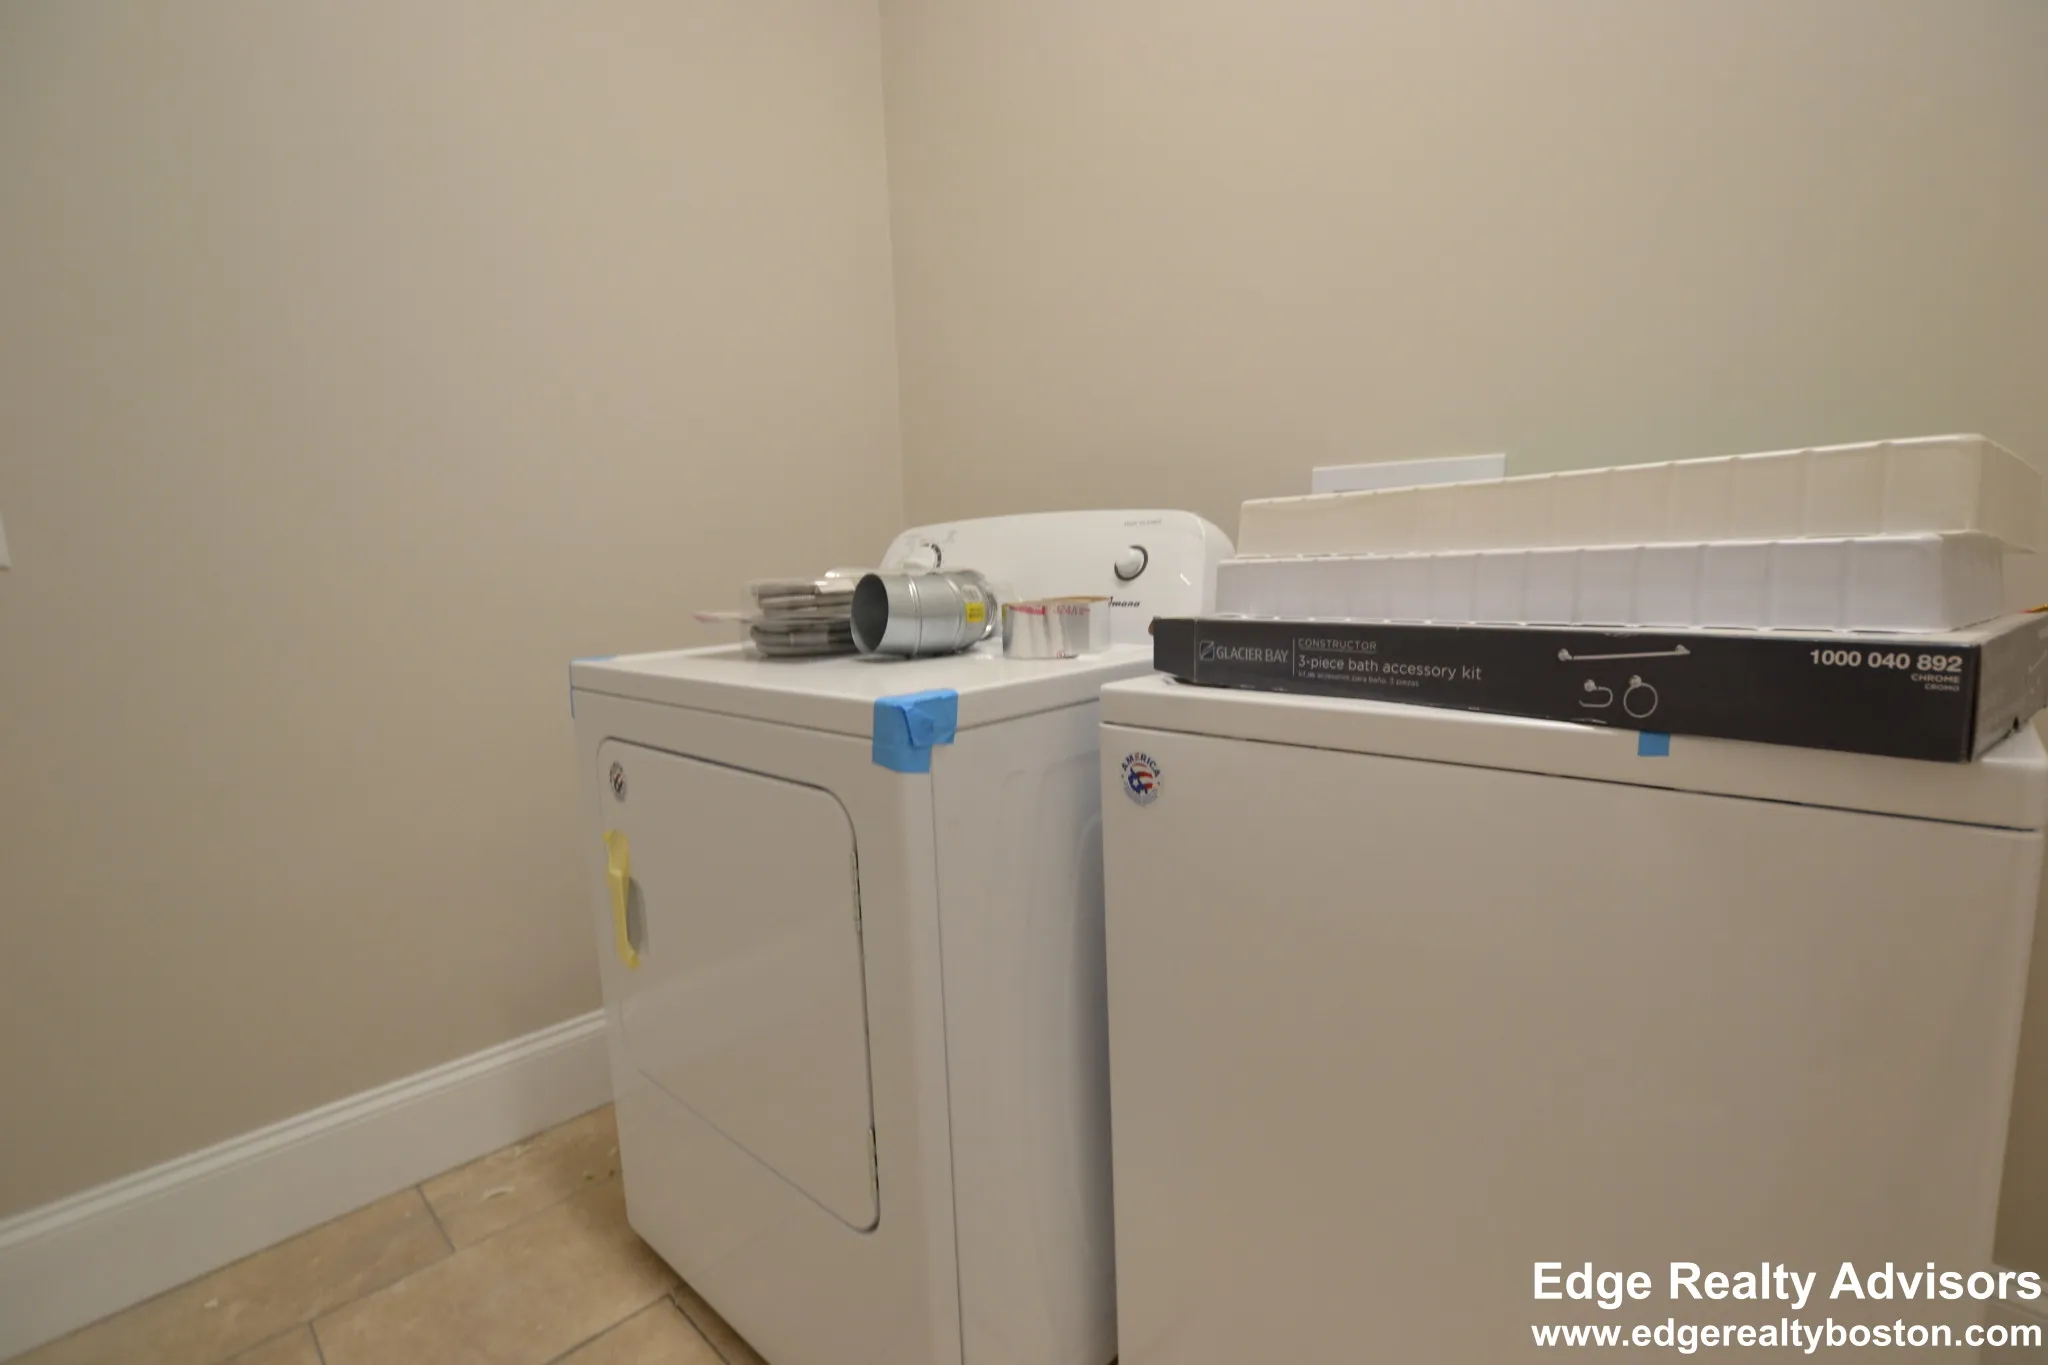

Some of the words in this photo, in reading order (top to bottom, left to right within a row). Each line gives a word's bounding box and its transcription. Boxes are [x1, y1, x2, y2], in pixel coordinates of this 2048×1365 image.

[1298, 638, 1377, 651] CONSTRUCTOR
[1216, 646, 1262, 661] GLACIER
[1265, 648, 1288, 662] BAY
[1810, 649, 1862, 667] 1000
[1867, 652, 1910, 670] 040
[1916, 654, 1963, 673] 892
[1299, 654, 1344, 670] 3-piece
[1348, 658, 1378, 672] bath
[1382, 662, 1456, 680] accessory
[1462, 665, 1482, 680] kit
[1910, 672, 1961, 684] CHROME
